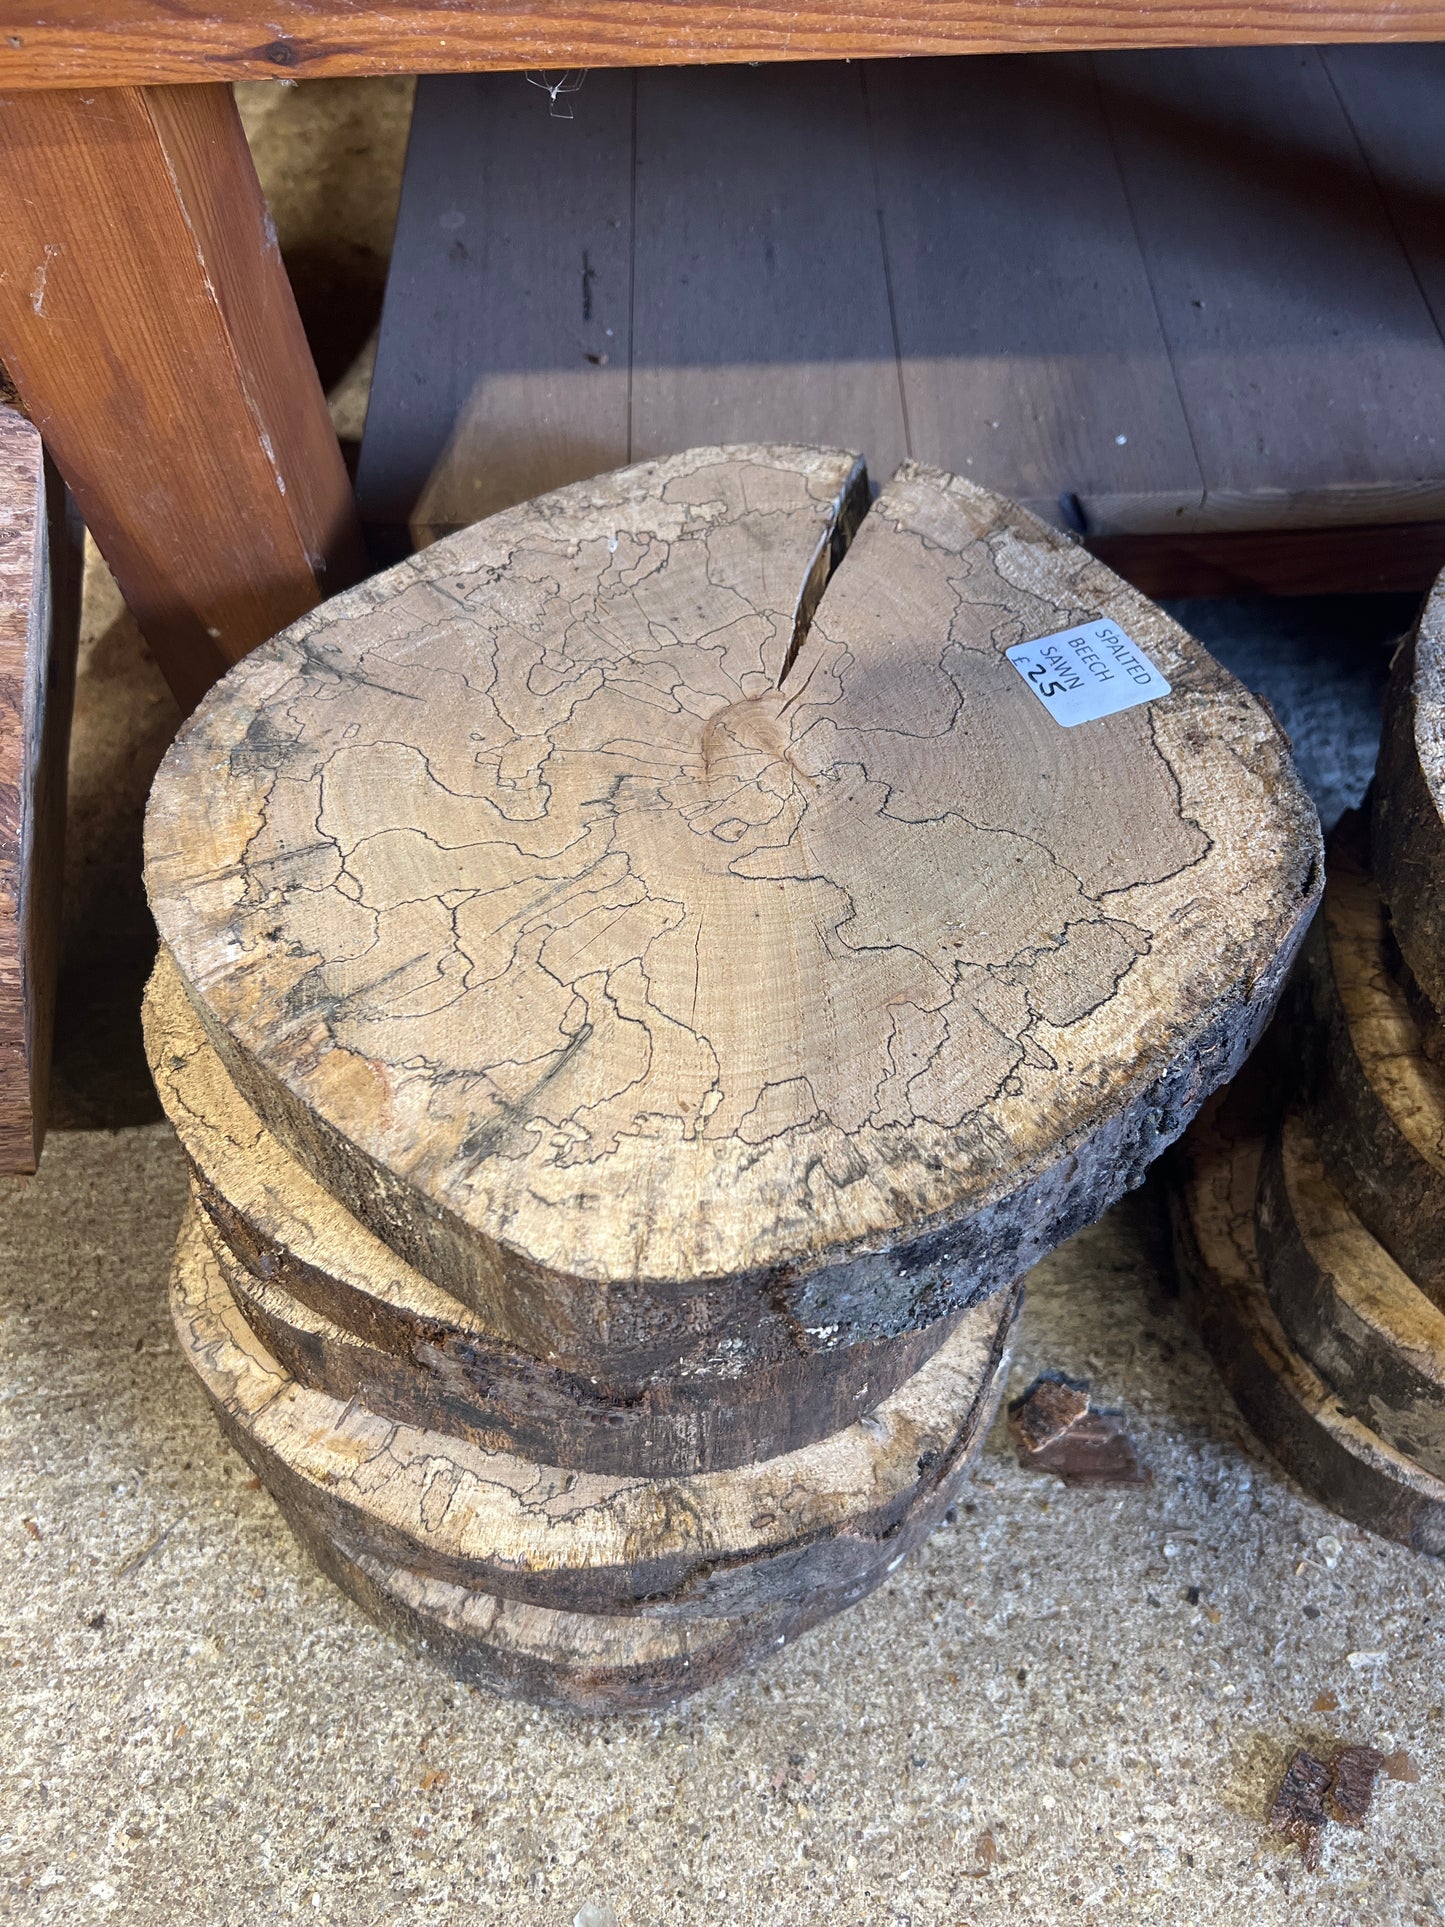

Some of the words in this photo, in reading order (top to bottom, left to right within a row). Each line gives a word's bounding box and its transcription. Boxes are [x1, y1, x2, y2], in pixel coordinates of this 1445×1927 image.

[1039, 646, 1085, 690] SAWN
[1067, 637, 1115, 682] BEECH
[1095, 628, 1151, 685] SPALTED
